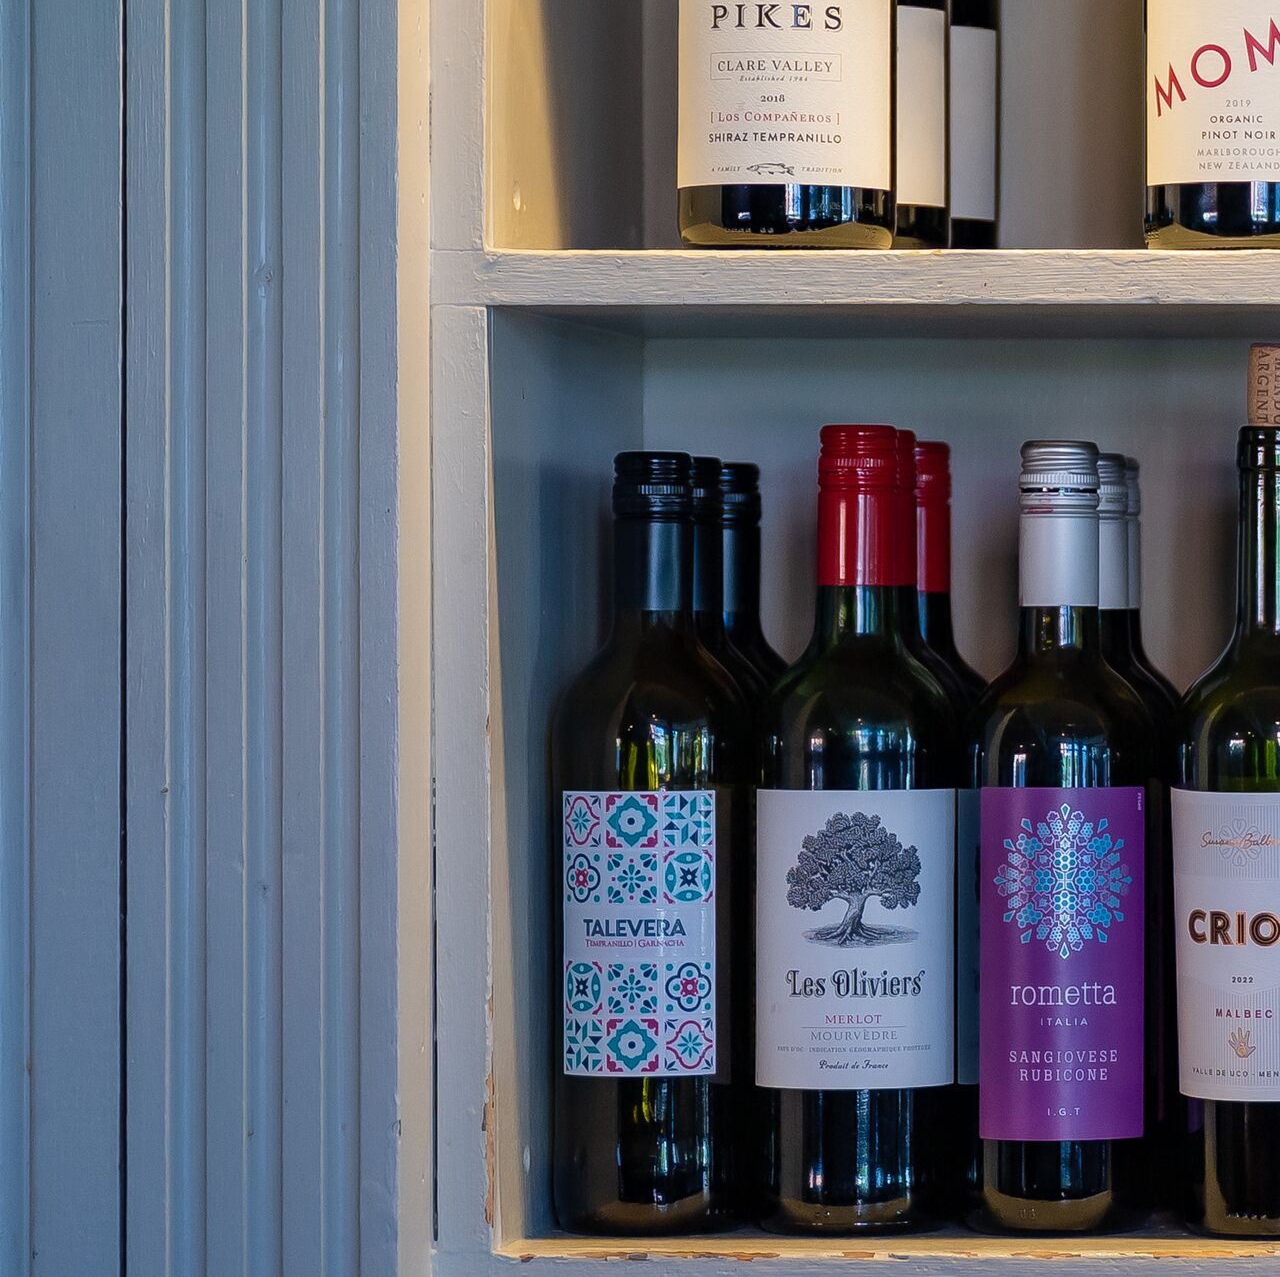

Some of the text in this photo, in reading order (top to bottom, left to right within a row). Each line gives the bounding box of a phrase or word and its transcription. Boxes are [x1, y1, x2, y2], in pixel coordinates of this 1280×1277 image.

[711, 4, 842, 31] PIKES
[718, 60, 833, 72] CLARE VALLEY
[760, 94, 785, 102] 2018
[1225, 99, 1251, 108] 2019
[1210, 115, 1263, 124] ORGANIC
[709, 132, 842, 144] SHIRAZ TEMPRANILLO
[1201, 131, 1276, 140] PINOT NOIR
[1199, 161, 1280, 171] NEW ZEALAND
[583, 918, 687, 937] TALEVERA
[585, 939, 633, 947] TEMPRANILLO
[785, 967, 926, 998] Les Oliviers
[1231, 976, 1254, 984] 2022
[1010, 982, 1117, 1006] rometta
[825, 1014, 882, 1024] MERLOT
[1215, 1008, 1274, 1019] MALBEC
[1040, 1017, 1088, 1026] ITALIA
[1009, 1050, 1118, 1064] SANGIOVESE
[819, 1059, 889, 1070] Produit de France
[1019, 1069, 1108, 1082] RUBICONE
